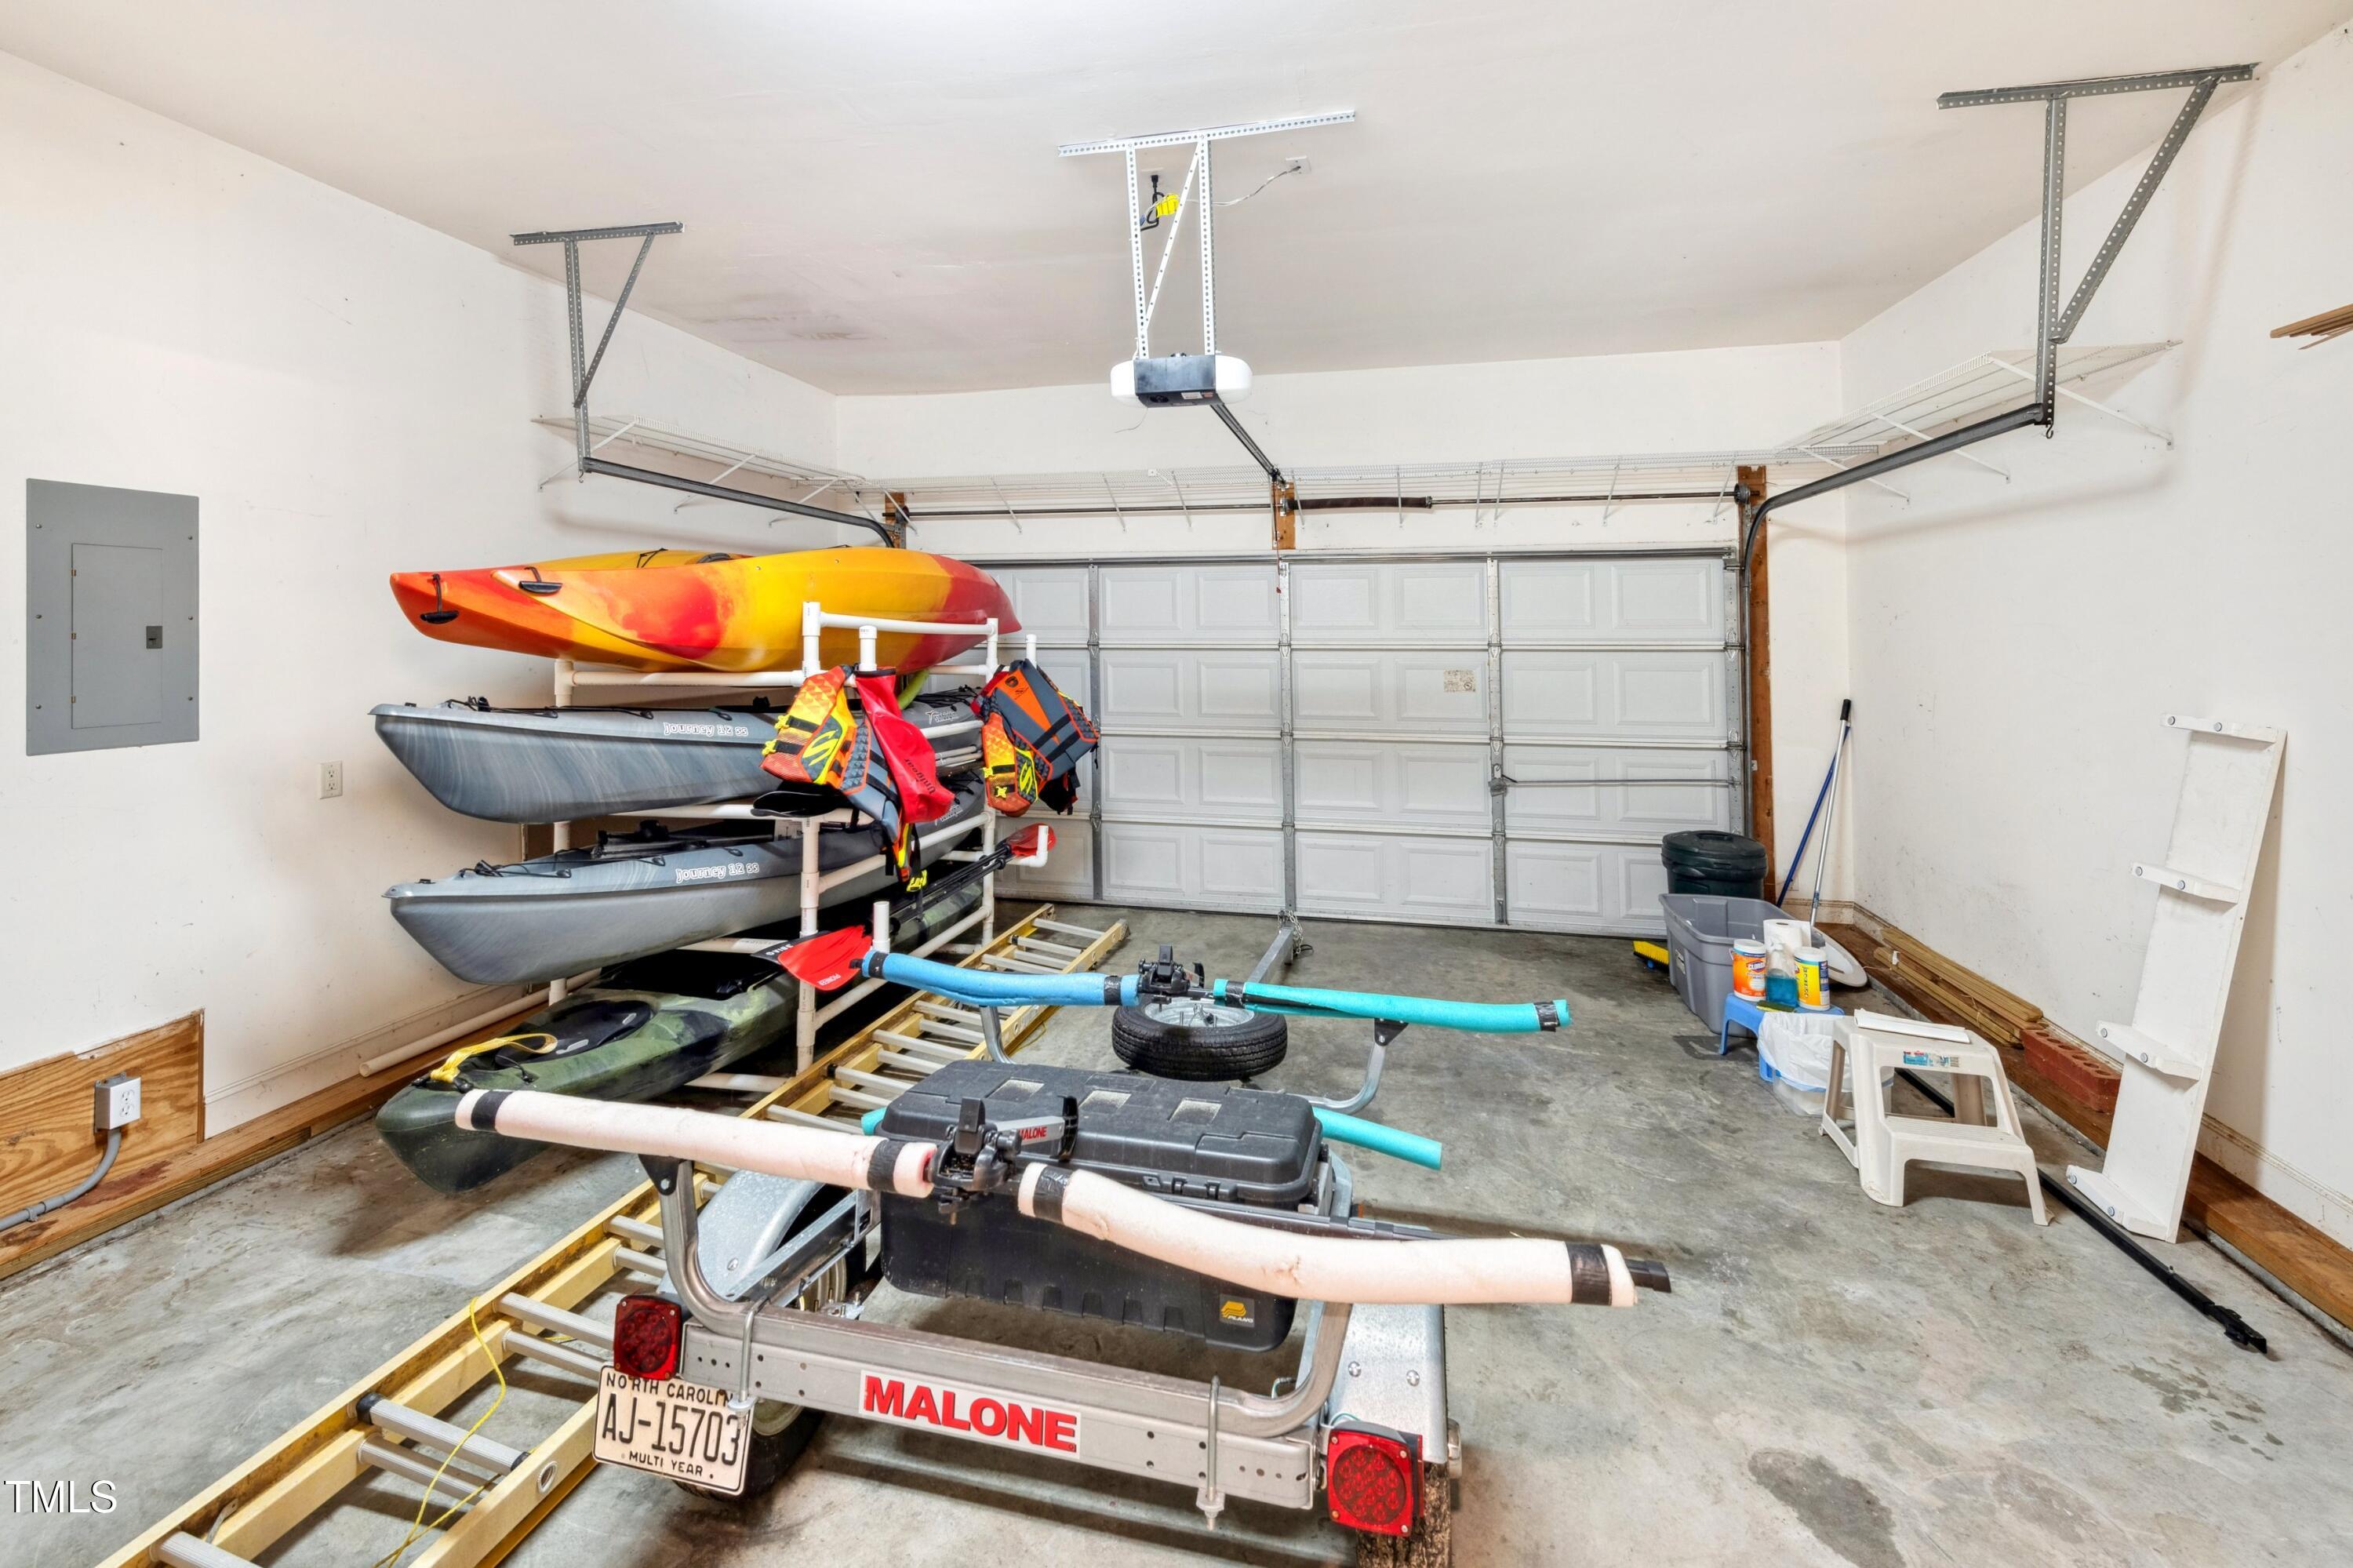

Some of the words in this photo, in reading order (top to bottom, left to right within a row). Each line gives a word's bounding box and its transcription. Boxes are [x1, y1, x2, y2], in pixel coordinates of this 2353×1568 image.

[717, 723, 733, 736] 12
[904, 758, 936, 794] Unigear
[728, 862, 745, 875] 12
[1227, 1315, 1254, 1323] PLANO
[606, 1372, 660, 1395] NORTH
[667, 1382, 733, 1407] CAROLIN
[864, 1374, 1077, 1453] MALONE
[602, 1392, 741, 1467] AJ-15703
[628, 1450, 664, 1468] MULTI
[671, 1459, 704, 1477] YEAR
